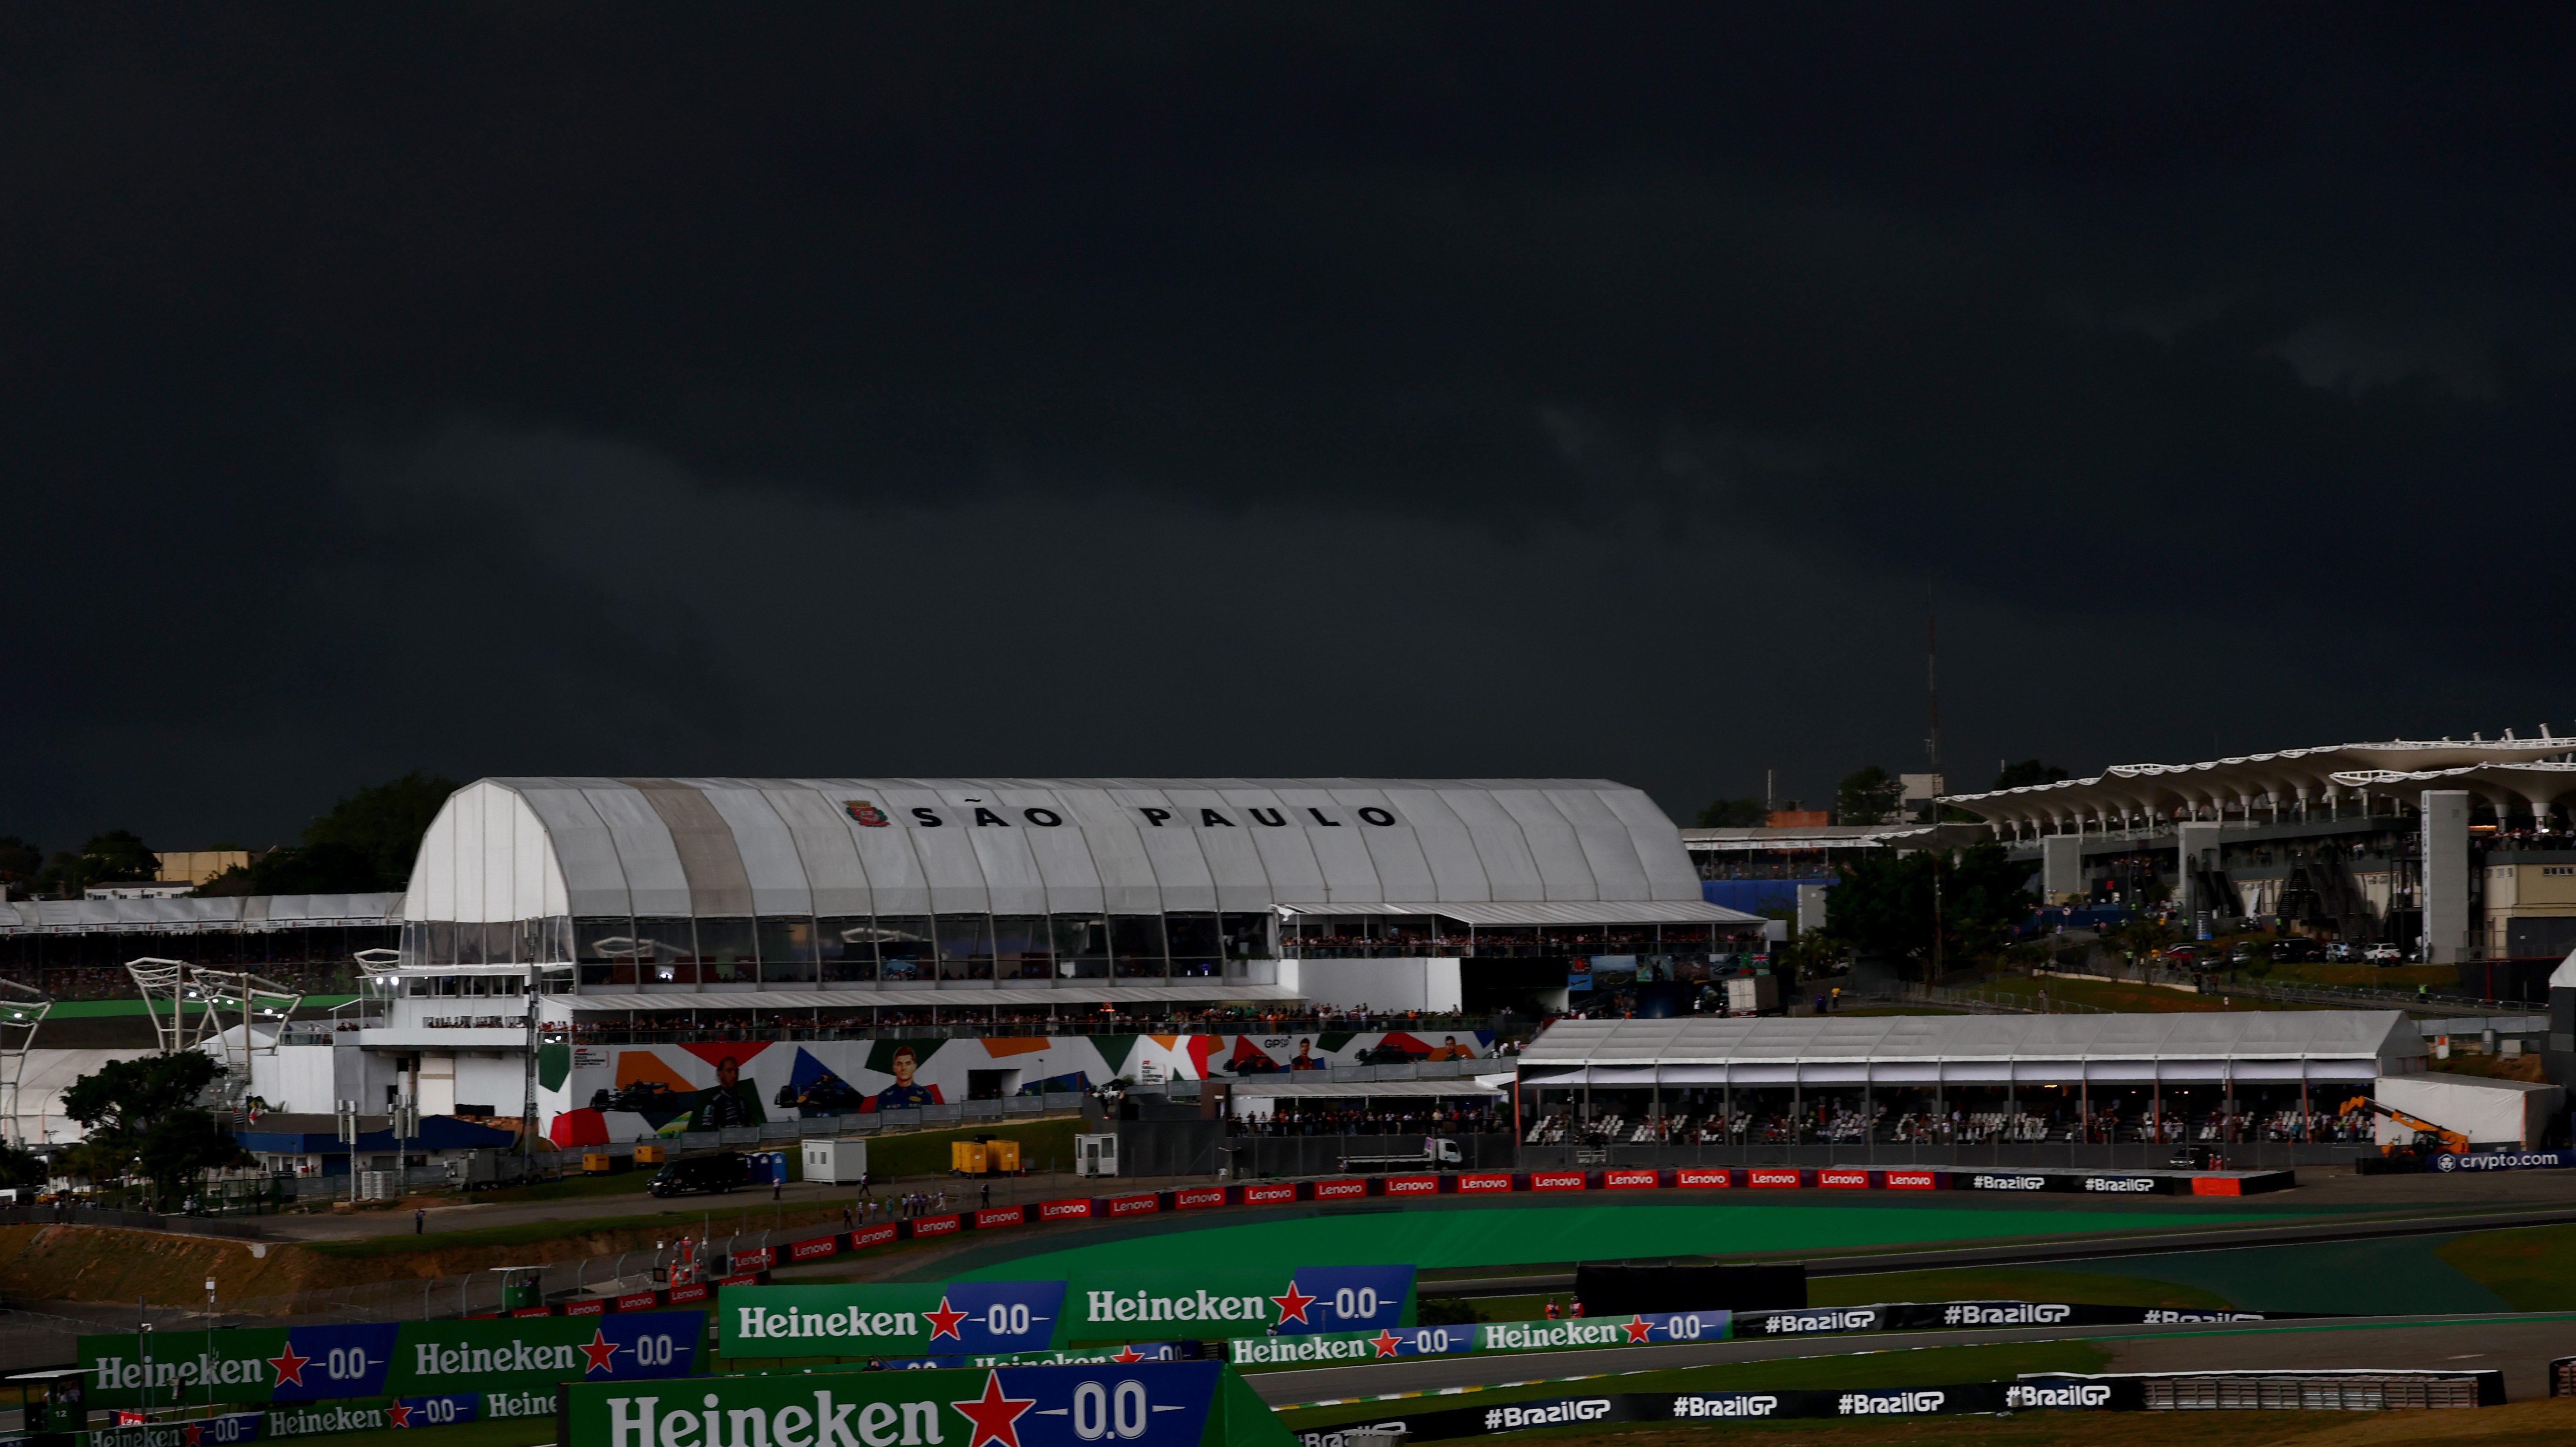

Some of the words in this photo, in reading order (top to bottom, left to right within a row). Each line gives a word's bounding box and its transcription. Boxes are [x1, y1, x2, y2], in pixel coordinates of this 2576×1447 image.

[912, 798, 1062, 827] SÃO
[1139, 807, 1395, 827] PAULO
[2461, 1154, 2558, 1169] crypto.com
[1389, 1182, 1434, 1191] Lenovo
[1461, 1179, 1507, 1189] Lenovo
[1536, 1177, 1580, 1187] Lenovo
[1609, 1175, 1654, 1185] Lenovo
[1681, 1174, 1725, 1183] Lenovo
[1753, 1173, 1796, 1183] Lenovo
[1822, 1173, 1864, 1184] Lenovo
[1889, 1175, 1931, 1185] Lenovo
[1973, 1175, 2045, 1190] #BrazilGP
[2085, 1178, 2154, 1191] #BrazilGP
[1179, 1193, 1221, 1204] Lenovo
[1249, 1189, 1291, 1200] Lenovo
[1319, 1184, 1362, 1195] Lenovo
[1044, 1203, 1086, 1216] Lenovo
[1113, 1200, 1154, 1212] Lenovo
[917, 1220, 956, 1233] Lenovo
[980, 1212, 1019, 1224] Lenovo
[855, 1230, 893, 1244] Lenovo
[794, 1242, 832, 1257] Lenovo
[620, 1297, 653, 1309] Lenovo
[671, 1289, 704, 1301] Lenovo
[1335, 1287, 1376, 1319] 0.0
[568, 1304, 601, 1315] Lenovo
[1086, 1290, 1267, 1322] Heineken
[1944, 1304, 2070, 1325] #BrazilGP
[738, 1306, 919, 1338] Heineken
[988, 1303, 1030, 1335] 0.0
[1668, 1314, 1700, 1339] 0.0
[1765, 1311, 1875, 1333] #BrazilGP
[1416, 1328, 1448, 1354] 0.0
[1485, 1321, 1618, 1349] Heineken
[414, 1339, 576, 1375] Heineken
[637, 1334, 672, 1366] 0.0
[1233, 1336, 1367, 1364] Heineken
[95, 1353, 264, 1390] Heineken
[328, 1346, 366, 1380] 0.0
[487, 1392, 557, 1417] Heine
[1674, 1395, 1778, 1417] #BrazilGP
[1838, 1391, 1945, 1414] #BrazilGP
[2006, 1385, 2111, 1407] #BrazilGP
[425, 1398, 455, 1423] 0.0
[606, 1390, 944, 1447] Heineken
[1072, 1379, 1148, 1440] 0.0
[1485, 1399, 1611, 1429] #BrazilGP
[214, 1418, 239, 1442] 0.0
[269, 1406, 383, 1437] Heineken
